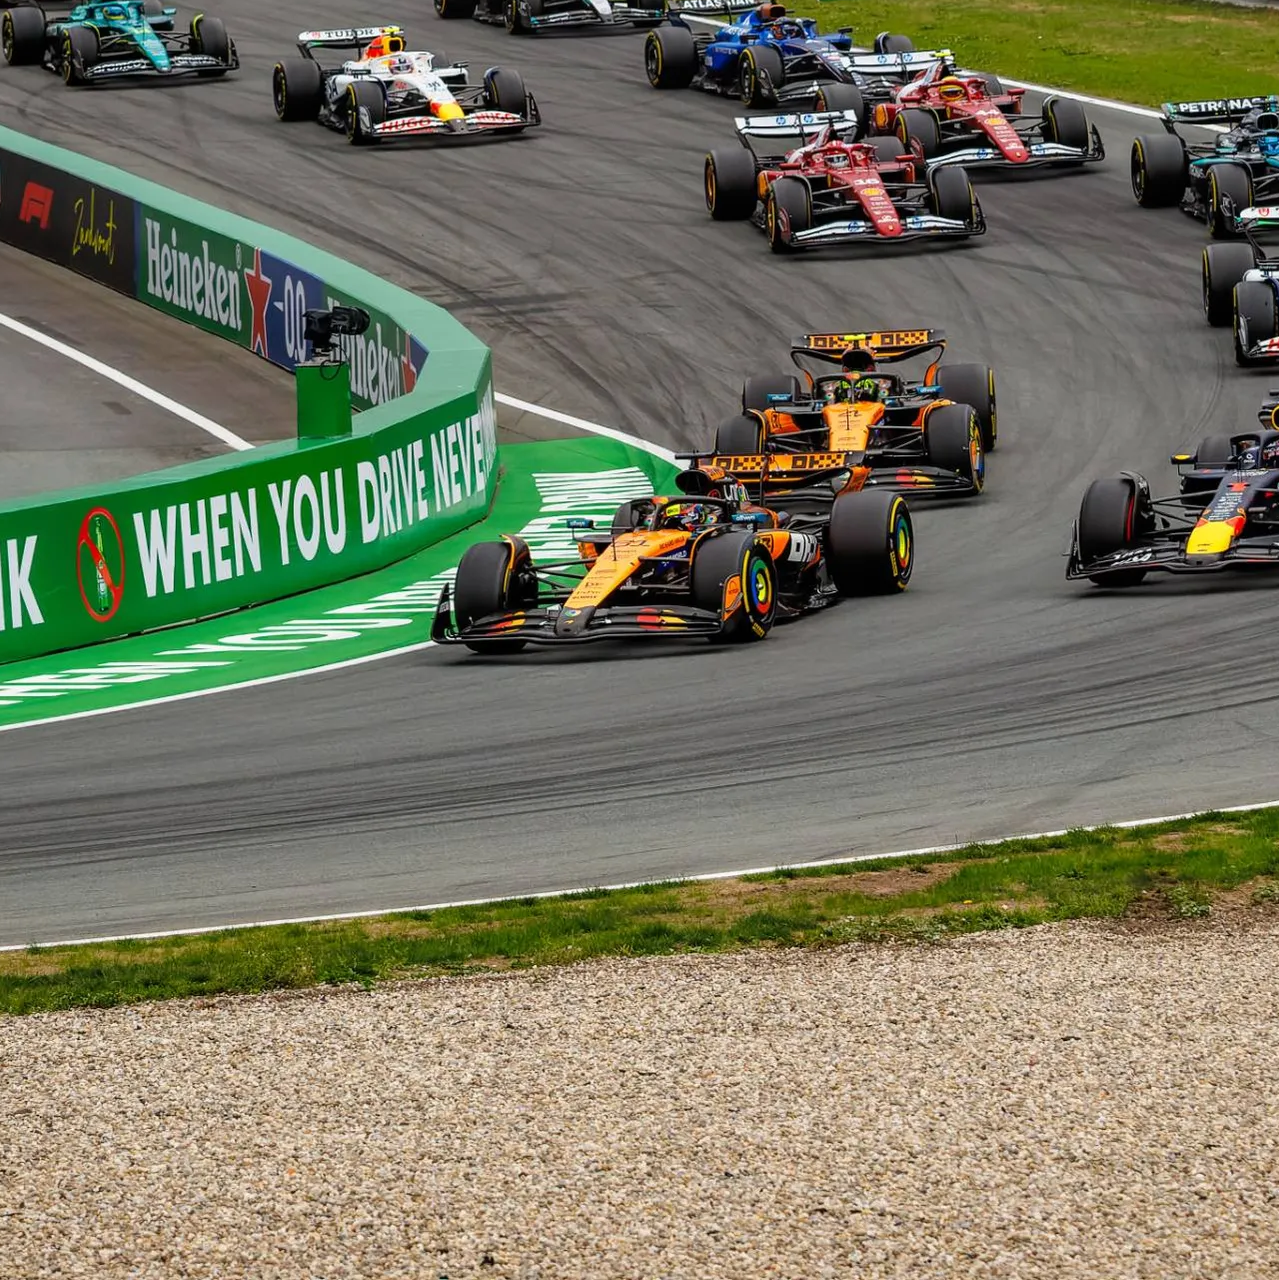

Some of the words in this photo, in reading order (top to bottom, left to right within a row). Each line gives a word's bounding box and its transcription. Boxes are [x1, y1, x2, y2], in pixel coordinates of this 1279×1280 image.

[381, 117, 432, 133] HUGO
[146, 218, 243, 332] Heineken
[132, 486, 264, 597] WHEN
[267, 467, 347, 567] YOU
[357, 439, 429, 544] DRIVE
